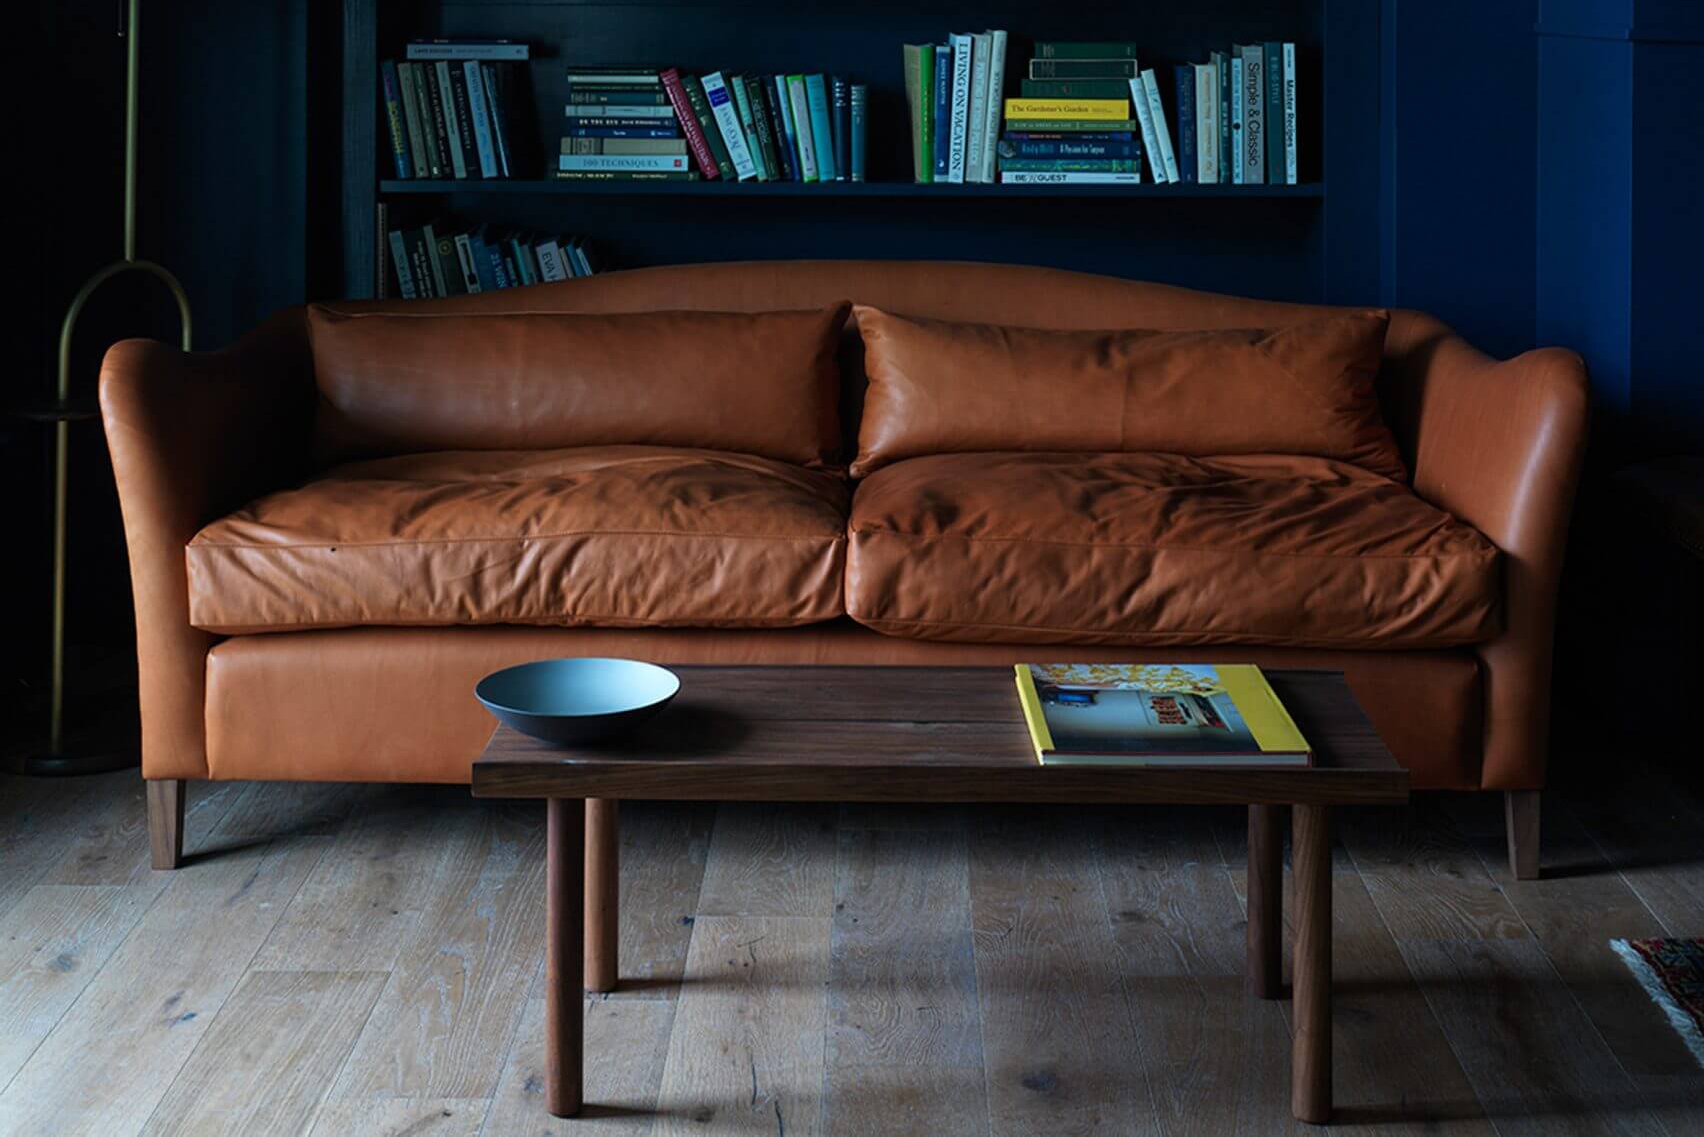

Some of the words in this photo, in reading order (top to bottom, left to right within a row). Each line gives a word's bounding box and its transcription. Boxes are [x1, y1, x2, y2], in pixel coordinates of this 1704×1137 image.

[959, 43, 970, 86] LIVING
[956, 89, 966, 107] ON
[1246, 63, 1261, 106] Simple
[1285, 79, 1294, 110] Master
[1063, 105, 1089, 113] Garden
[1249, 109, 1260, 118] &
[952, 110, 966, 171] VACATION
[1248, 120, 1261, 167] Classic
[1284, 112, 1294, 147] Recipes
[602, 159, 659, 168] TECHNIQUES
[542, 251, 555, 274] EVA
